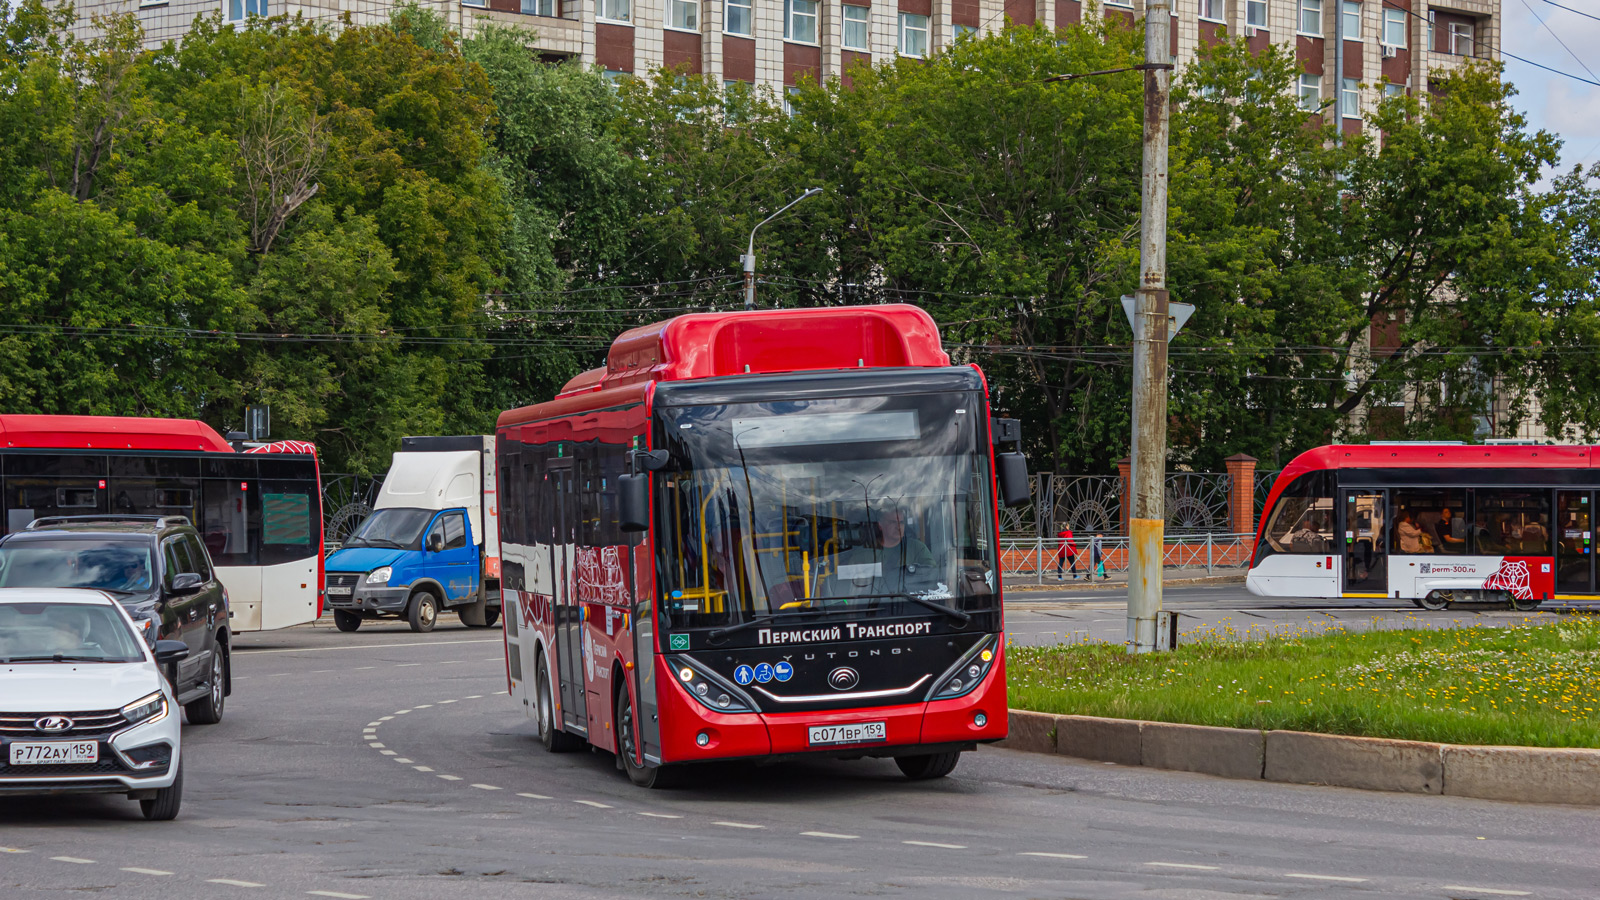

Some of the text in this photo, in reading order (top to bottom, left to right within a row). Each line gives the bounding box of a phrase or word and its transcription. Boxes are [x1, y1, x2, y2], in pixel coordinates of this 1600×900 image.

[782, 648, 902, 661] YUTONG
[864, 724, 882, 734] 159
[73, 744, 93, 754] 159
